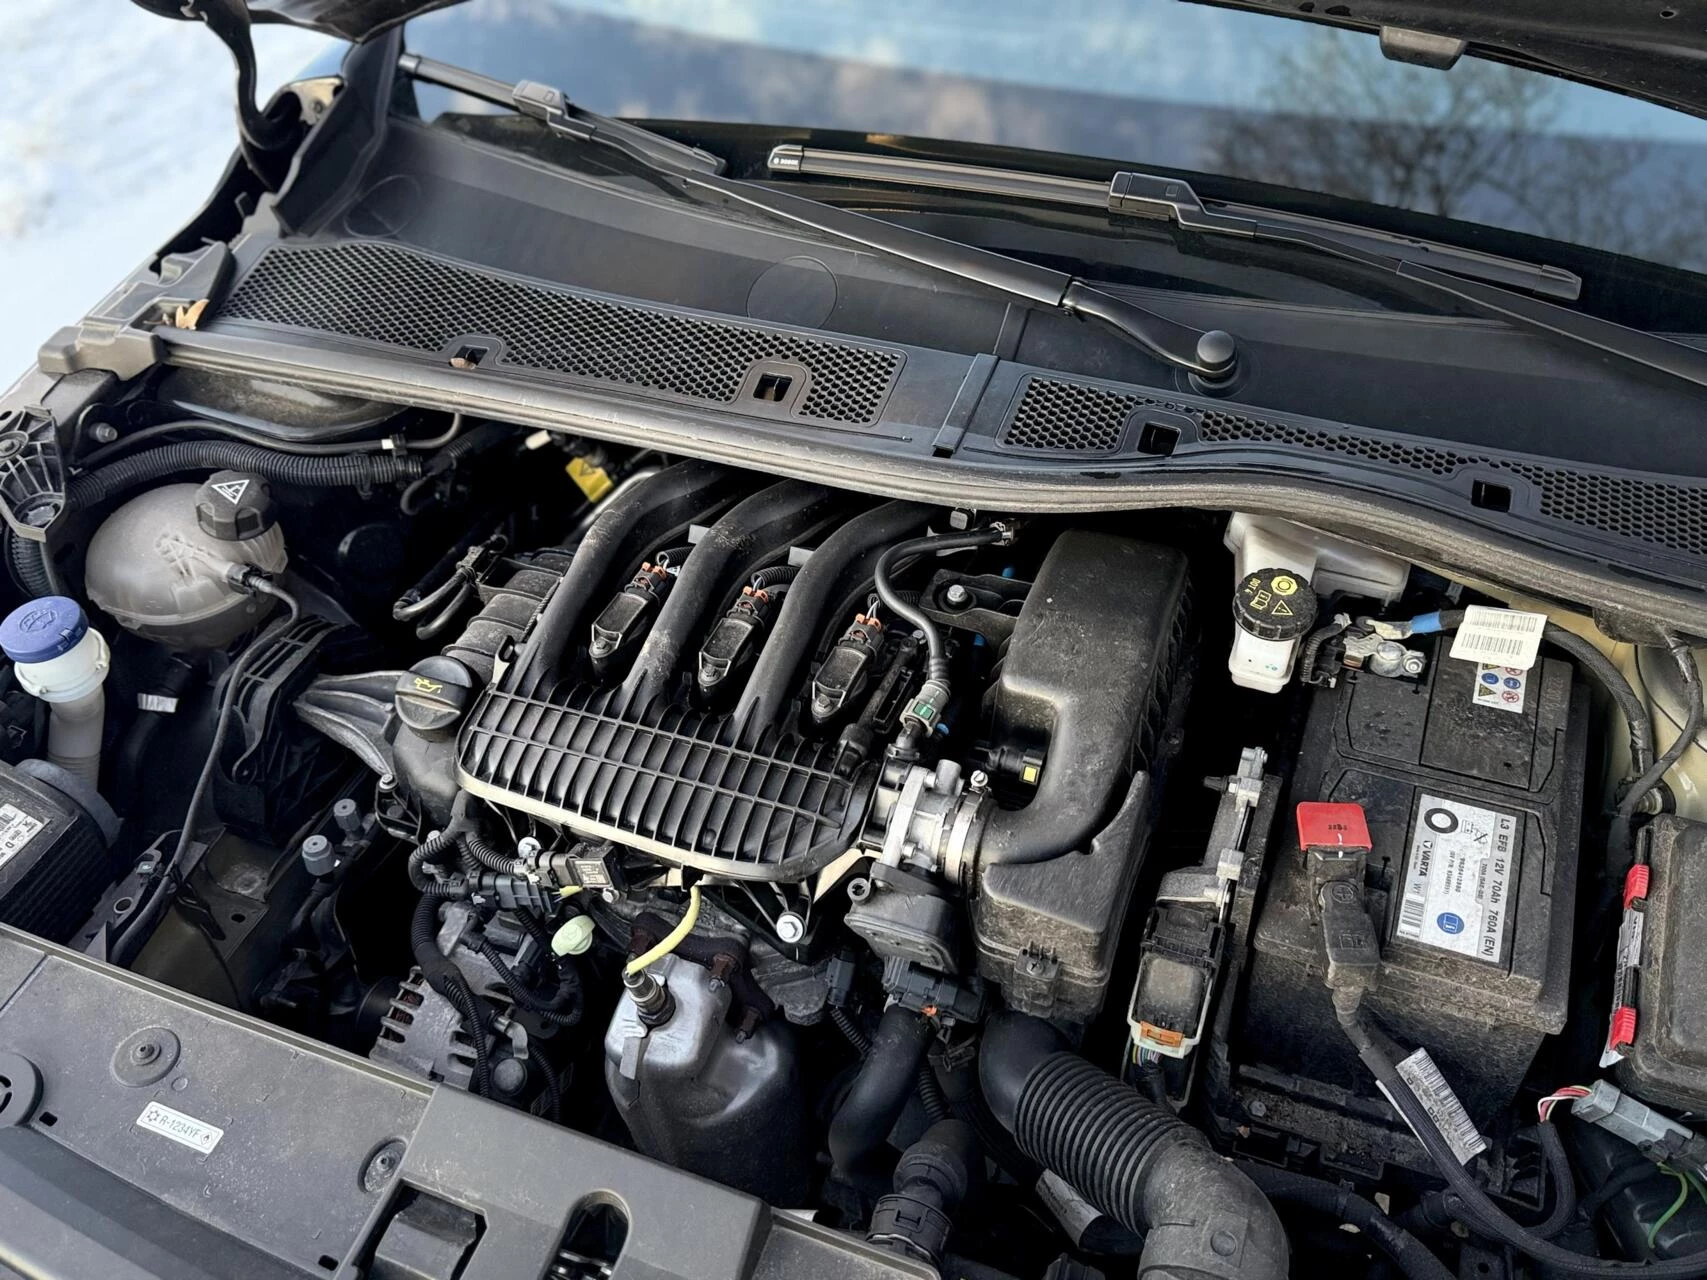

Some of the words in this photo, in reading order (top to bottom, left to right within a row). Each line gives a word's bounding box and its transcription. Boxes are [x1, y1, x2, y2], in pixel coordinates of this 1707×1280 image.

[1248, 578, 1261, 590] DOT
[1500, 818, 1511, 830] L3
[1497, 834, 1509, 852] EFB
[1418, 850, 1432, 877] VARTA
[1494, 858, 1505, 876] 12V
[1490, 880, 1504, 904] 70Ah
[1486, 909, 1499, 933] 760A
[1480, 935, 1496, 957] (EN)
[160, 1115, 201, 1138] R-1234YF
